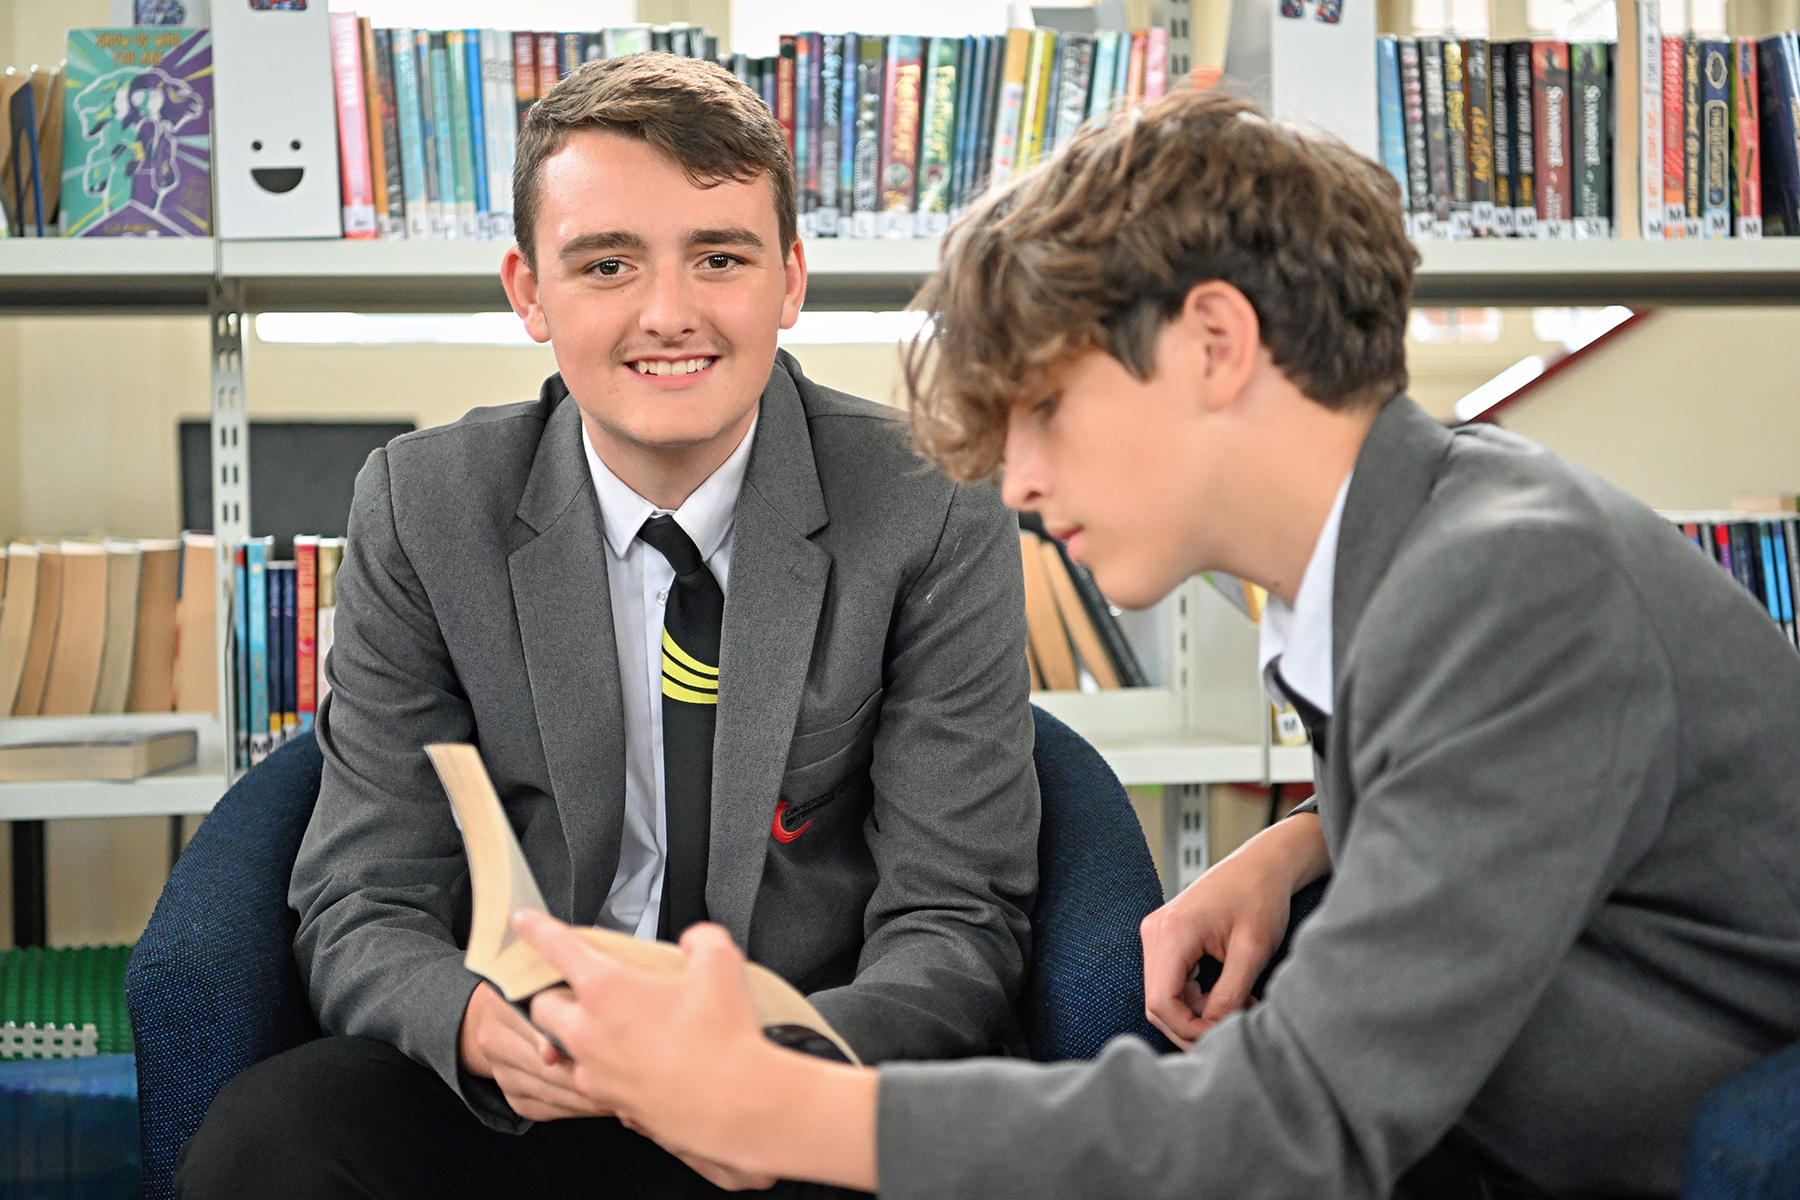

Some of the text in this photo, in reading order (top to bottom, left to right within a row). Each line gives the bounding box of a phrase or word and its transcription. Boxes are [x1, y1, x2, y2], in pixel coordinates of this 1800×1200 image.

[1546, 86, 1563, 168] SUMMONER
[1584, 85, 1601, 167] SUMMONER
[1712, 216, 1725, 229] M
[1746, 222, 1758, 236] M
